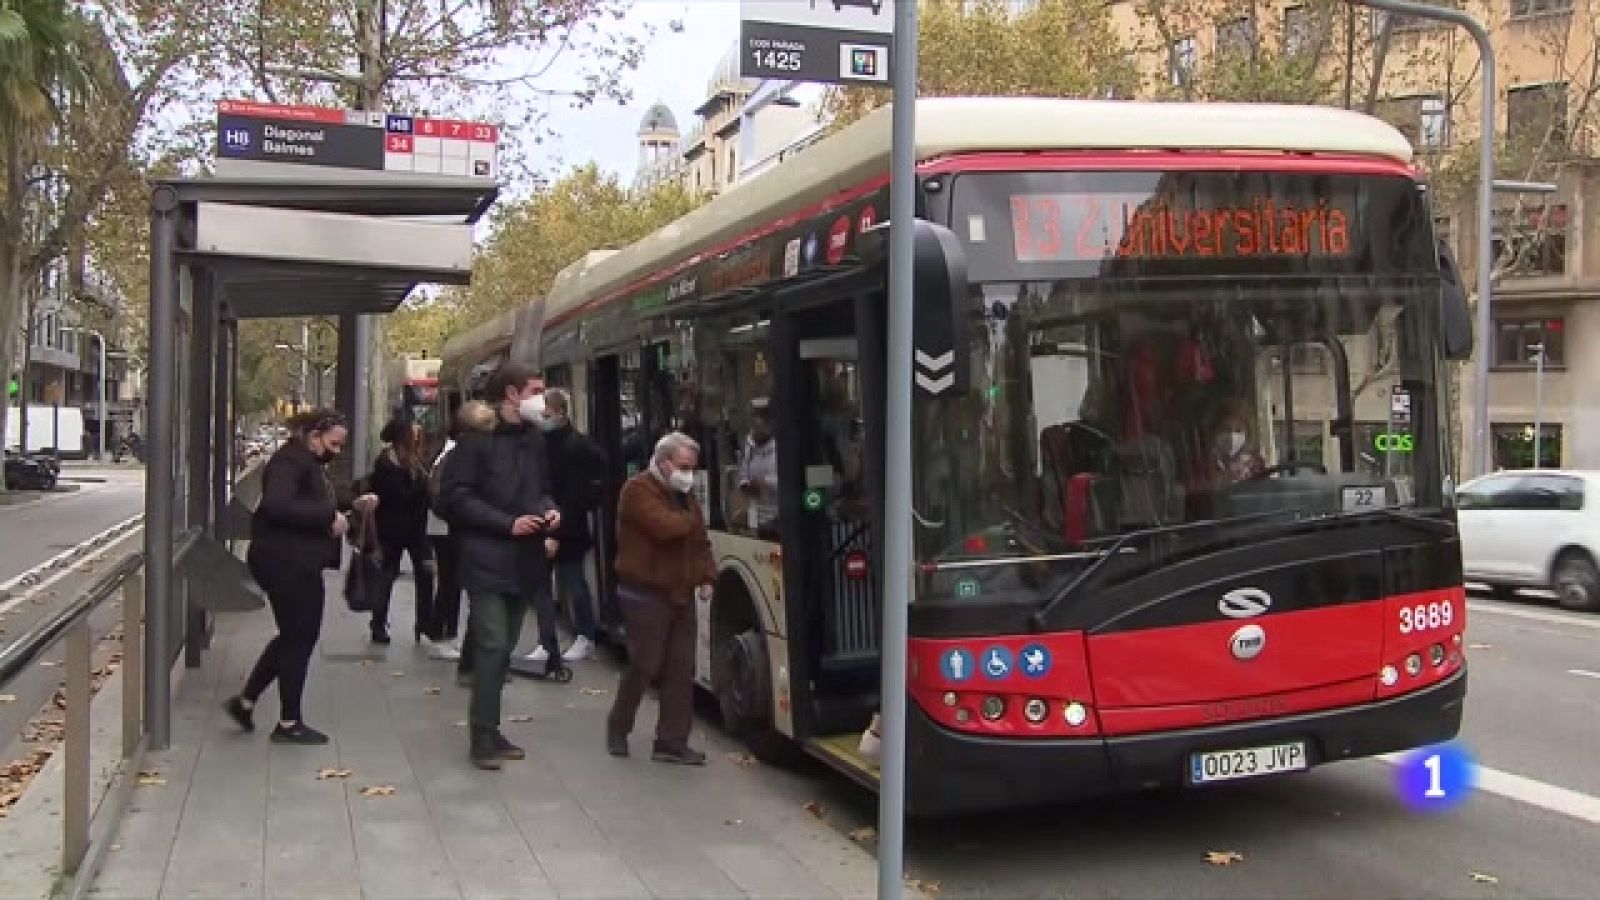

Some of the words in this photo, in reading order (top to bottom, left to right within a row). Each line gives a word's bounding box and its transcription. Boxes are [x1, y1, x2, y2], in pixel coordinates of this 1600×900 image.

[752, 50, 801, 71] 1425
[264, 124, 326, 142] Diagonal
[264, 139, 316, 156] Balmes
[1354, 488, 1374, 506] 22
[1399, 599, 1454, 634] 3689
[1204, 750, 1258, 776] 0023
[1264, 744, 1301, 770] JVP
